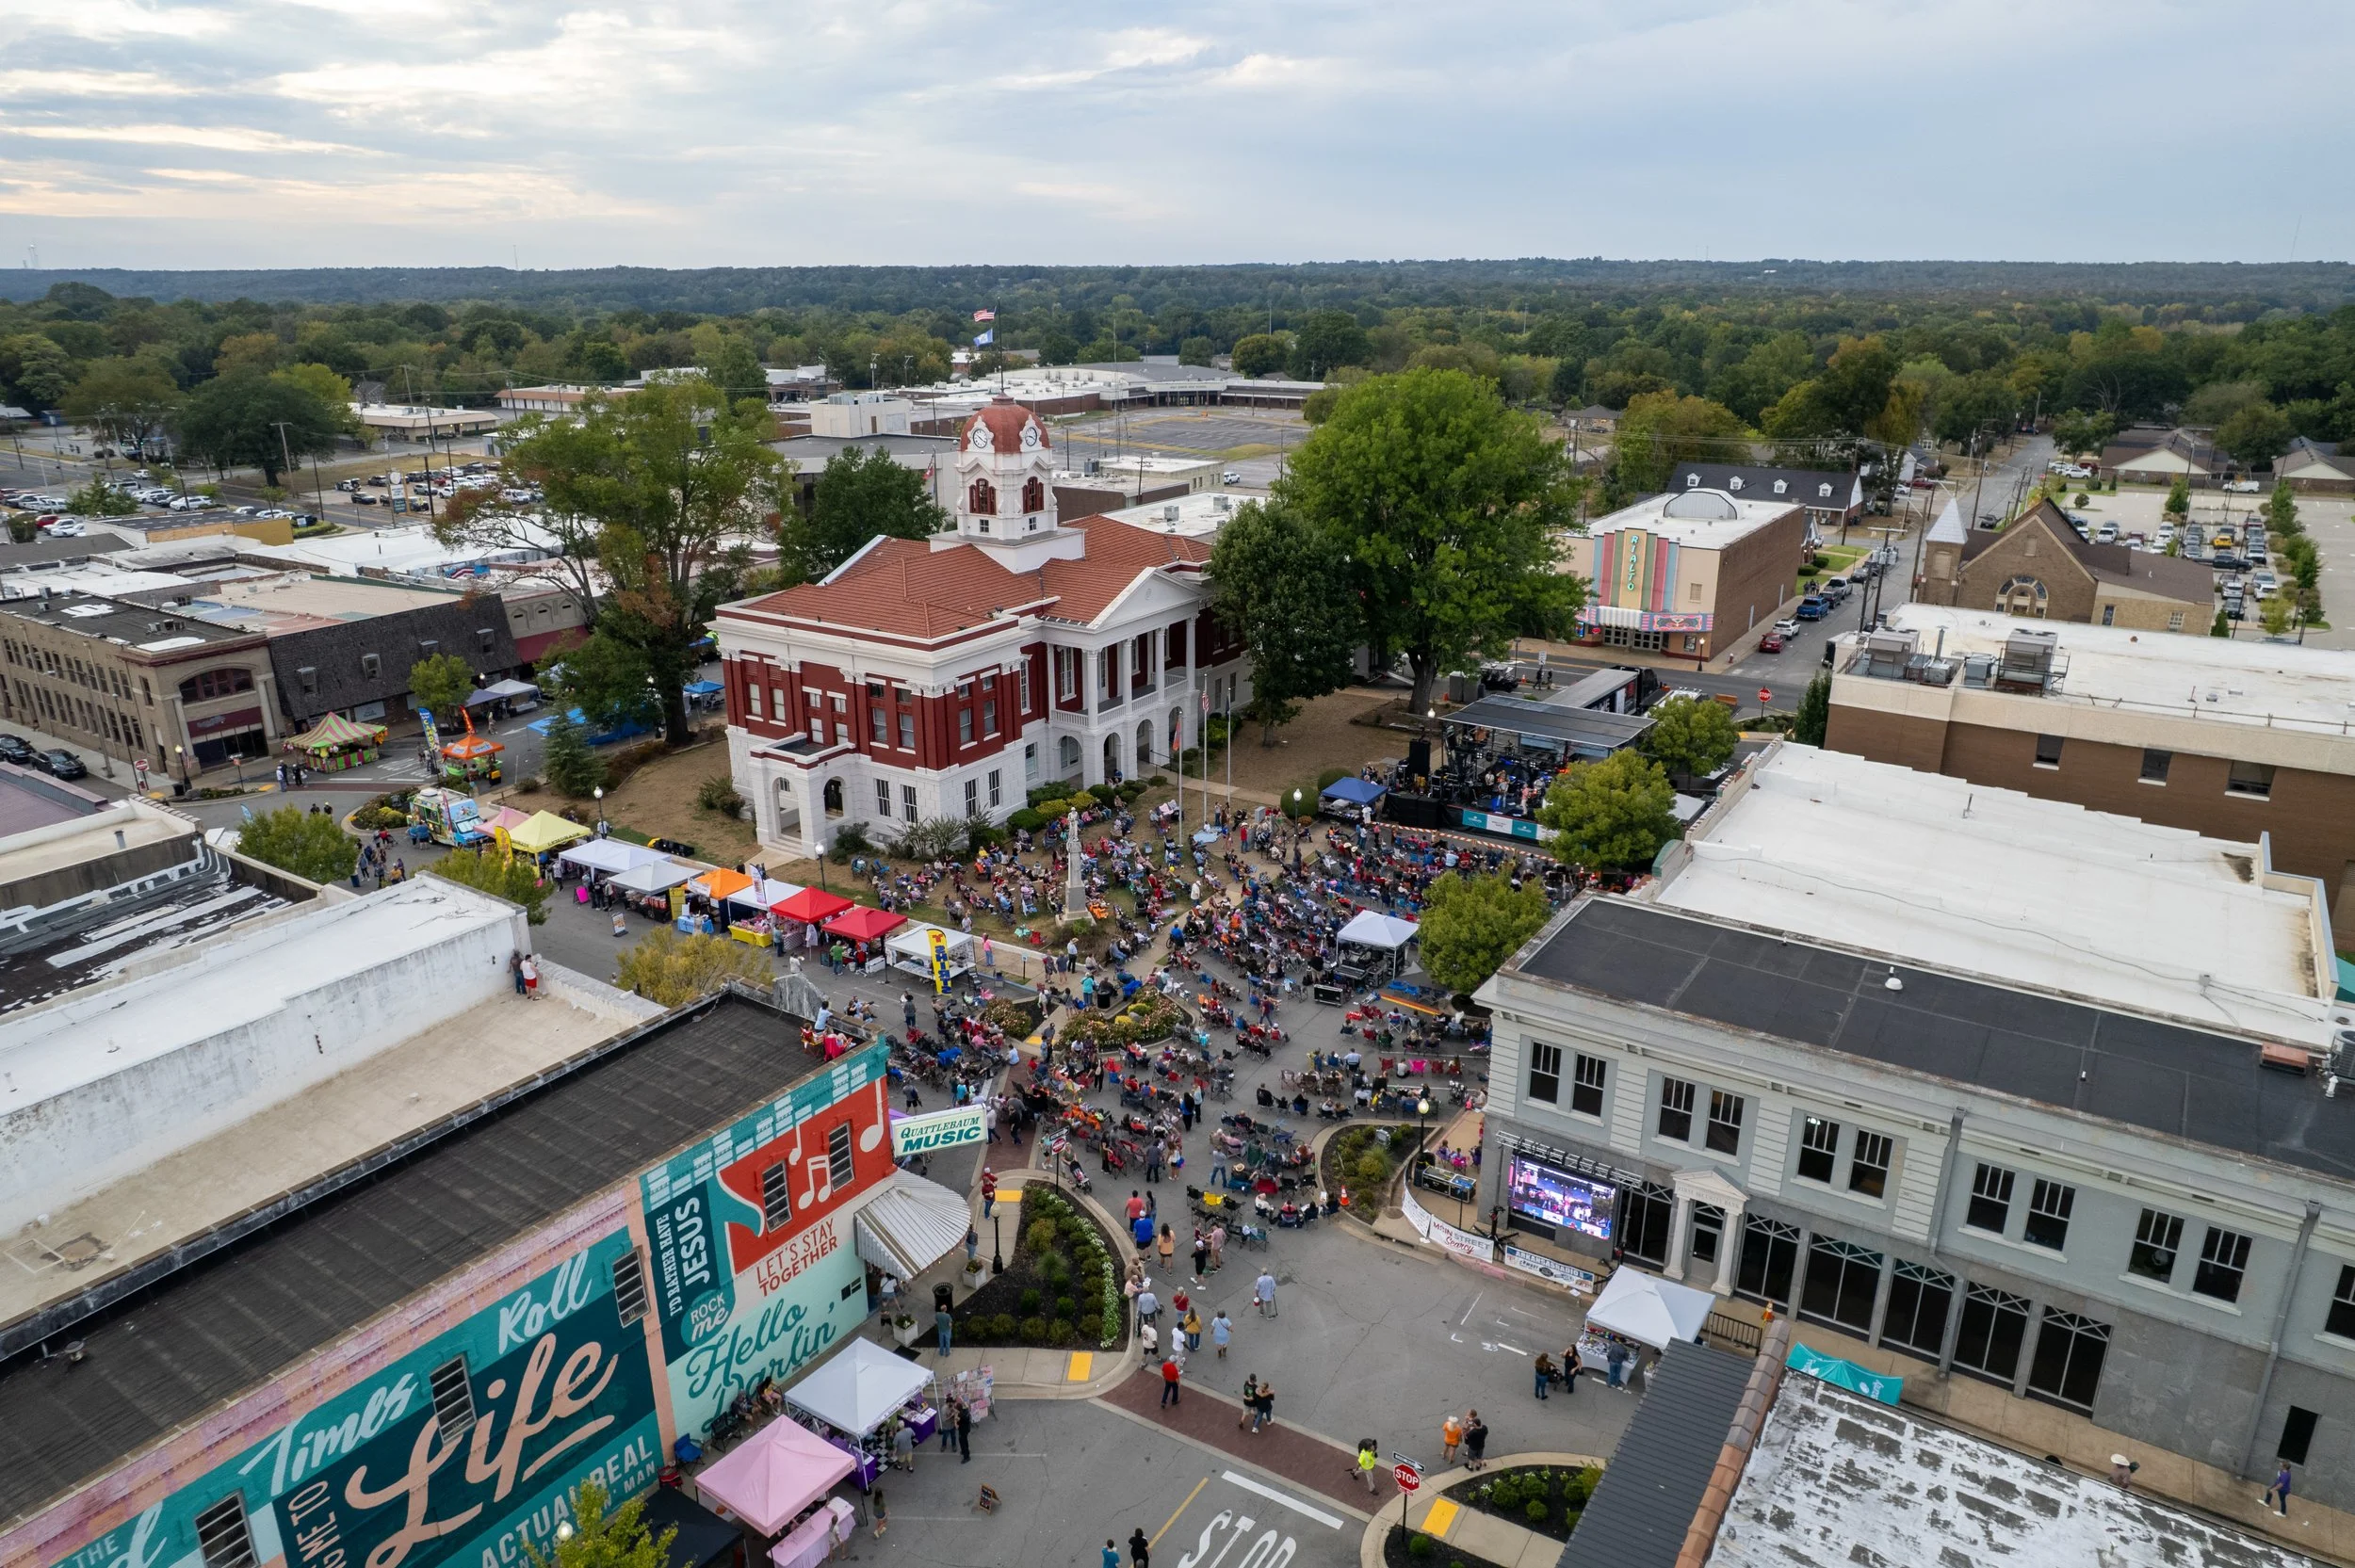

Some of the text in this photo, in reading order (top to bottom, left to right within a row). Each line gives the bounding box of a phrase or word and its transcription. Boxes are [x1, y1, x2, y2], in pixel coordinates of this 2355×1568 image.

[1627, 535, 1639, 591] RIALTO
[901, 1116, 981, 1139] QUATTLEBAUM
[902, 1125, 982, 1153] MUSIC
[656, 1213, 683, 1317] I'D RATHER HAVE
[674, 1197, 710, 1286] JESUS
[755, 1218, 835, 1285] LET'S STAY
[759, 1236, 838, 1298] TOGETHER
[1445, 1236, 1475, 1254] Searcy
[1454, 1233, 1490, 1251] STREET
[498, 1249, 593, 1354] Roll
[690, 1292, 725, 1326] ROCK
[690, 1307, 729, 1342] me
[686, 1298, 808, 1398] Hello
[238, 1373, 419, 1497] Times
[345, 1333, 620, 1568] Life
[589, 1435, 653, 1496] REAL
[623, 1461, 657, 1495] MAN
[1395, 1468, 1419, 1486] STOP
[287, 1480, 331, 1527] TO
[72, 1533, 120, 1568] THE
